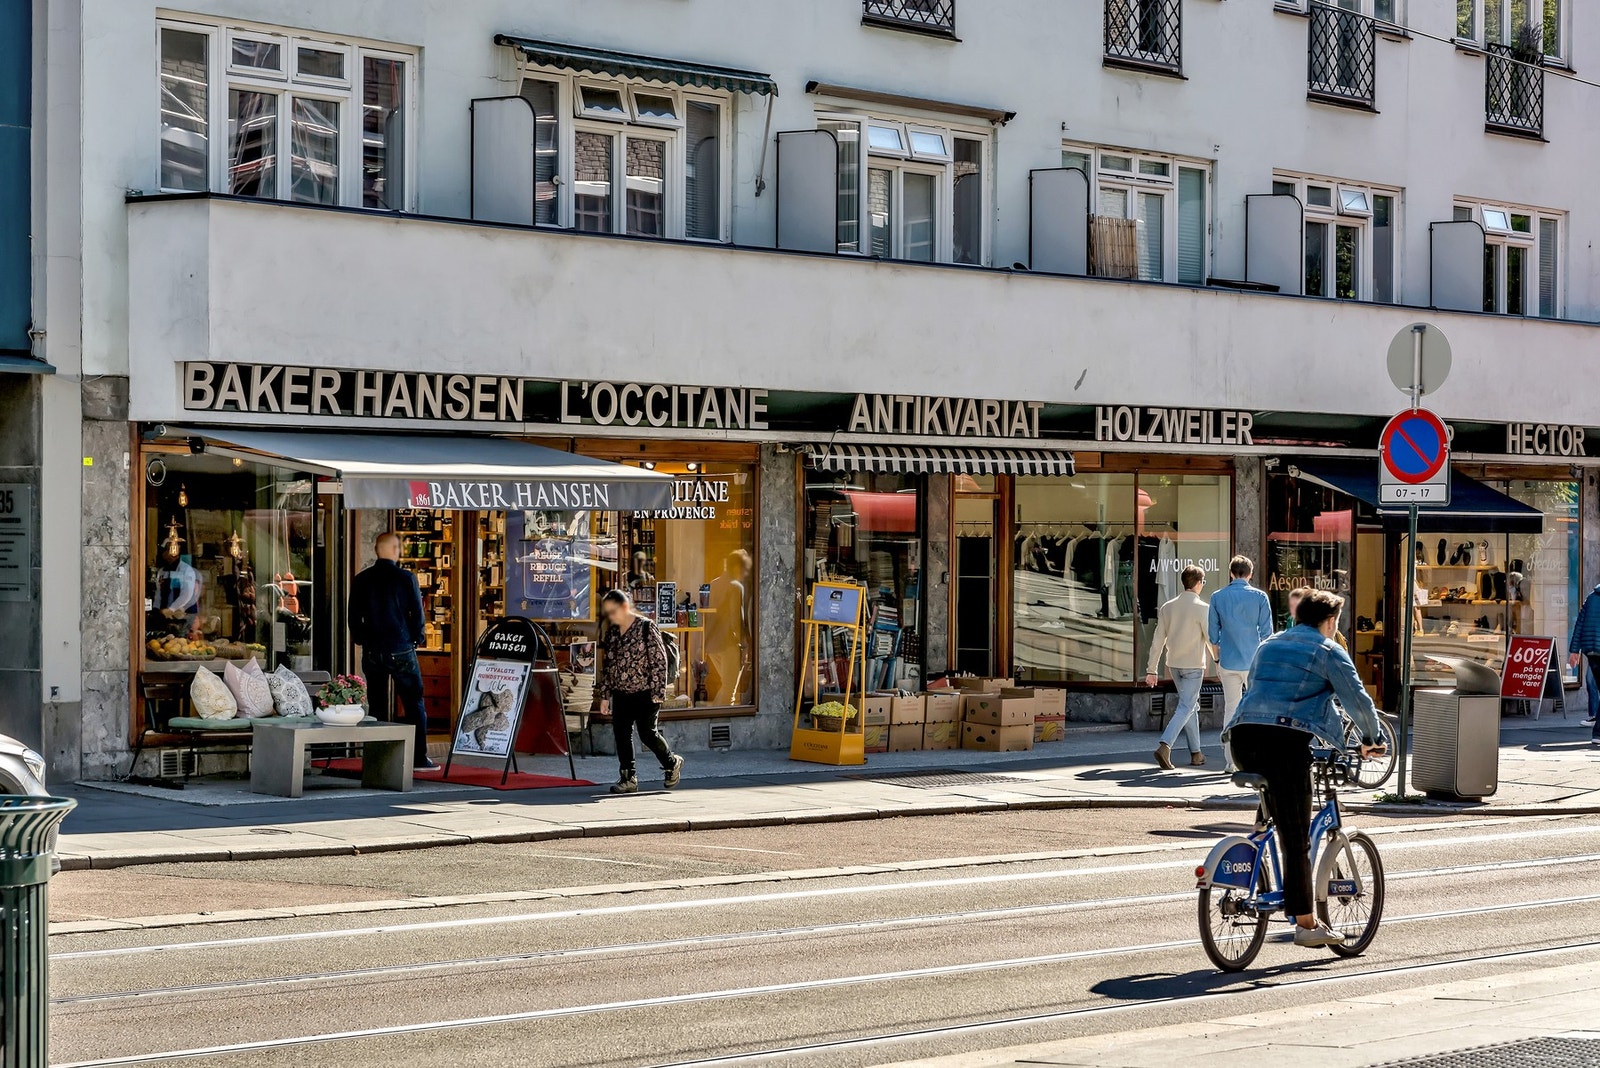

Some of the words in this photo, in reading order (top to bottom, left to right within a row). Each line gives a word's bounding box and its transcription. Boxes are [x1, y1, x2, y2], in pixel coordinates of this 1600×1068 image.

[184, 361, 341, 415] BAKER
[355, 370, 524, 421] HANSEN
[560, 381, 769, 430] L'OCCITANE
[847, 392, 1045, 438] ANTIKVARIAT
[1095, 405, 1254, 445] HOLZWEILER
[1506, 422, 1586, 457] HECTOR
[415, 493, 430, 506] 1861
[429, 482, 511, 508] BAKER
[514, 483, 610, 508] HANSEN
[1395, 488, 1408, 498] 07
[1420, 488, 1430, 498] 17
[653, 506, 716, 519] PROVENCE
[534, 551, 563, 560] REUSE
[530, 562, 567, 571] REDUCE
[1198, 558, 1220, 572] SOIL
[533, 573, 564, 582] REFILL
[1512, 672, 1542, 681] mengde
[1232, 861, 1252, 873] OBOS
[1338, 884, 1353, 893] OBOS
